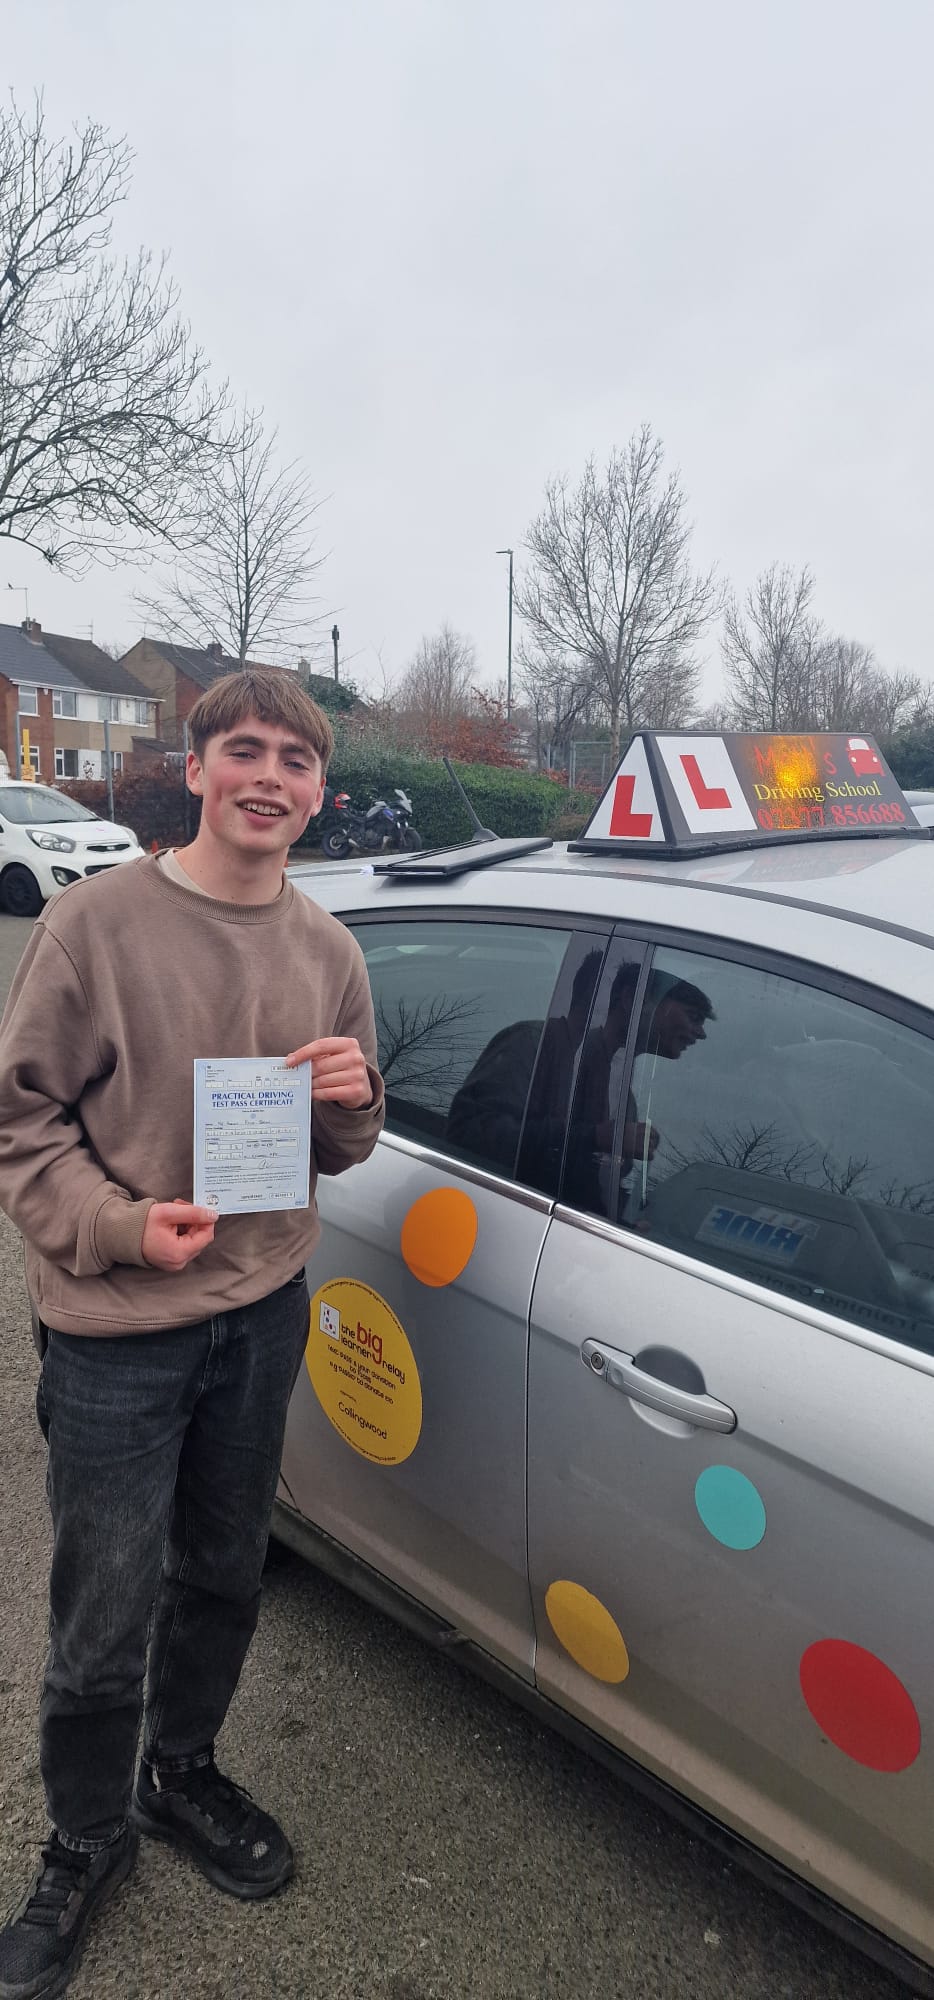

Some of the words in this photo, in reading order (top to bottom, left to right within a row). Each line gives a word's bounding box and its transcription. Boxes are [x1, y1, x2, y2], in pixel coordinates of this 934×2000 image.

[680, 755, 732, 810] L
[753, 783, 825, 802] Driving
[826, 780, 883, 798] School
[609, 775, 653, 837] L
[831, 802, 906, 827] 856688
[212, 1092, 255, 1101] PRACTICAL
[258, 1091, 294, 1099] DRIVING
[212, 1100, 229, 1108] TEST
[249, 1099, 293, 1107] CERTIFICATE
[341, 1323, 356, 1339] the
[356, 1321, 383, 1365] big
[341, 1334, 372, 1359] learner
[382, 1360, 405, 1385] relay
[338, 1401, 387, 1440] Collingwood
